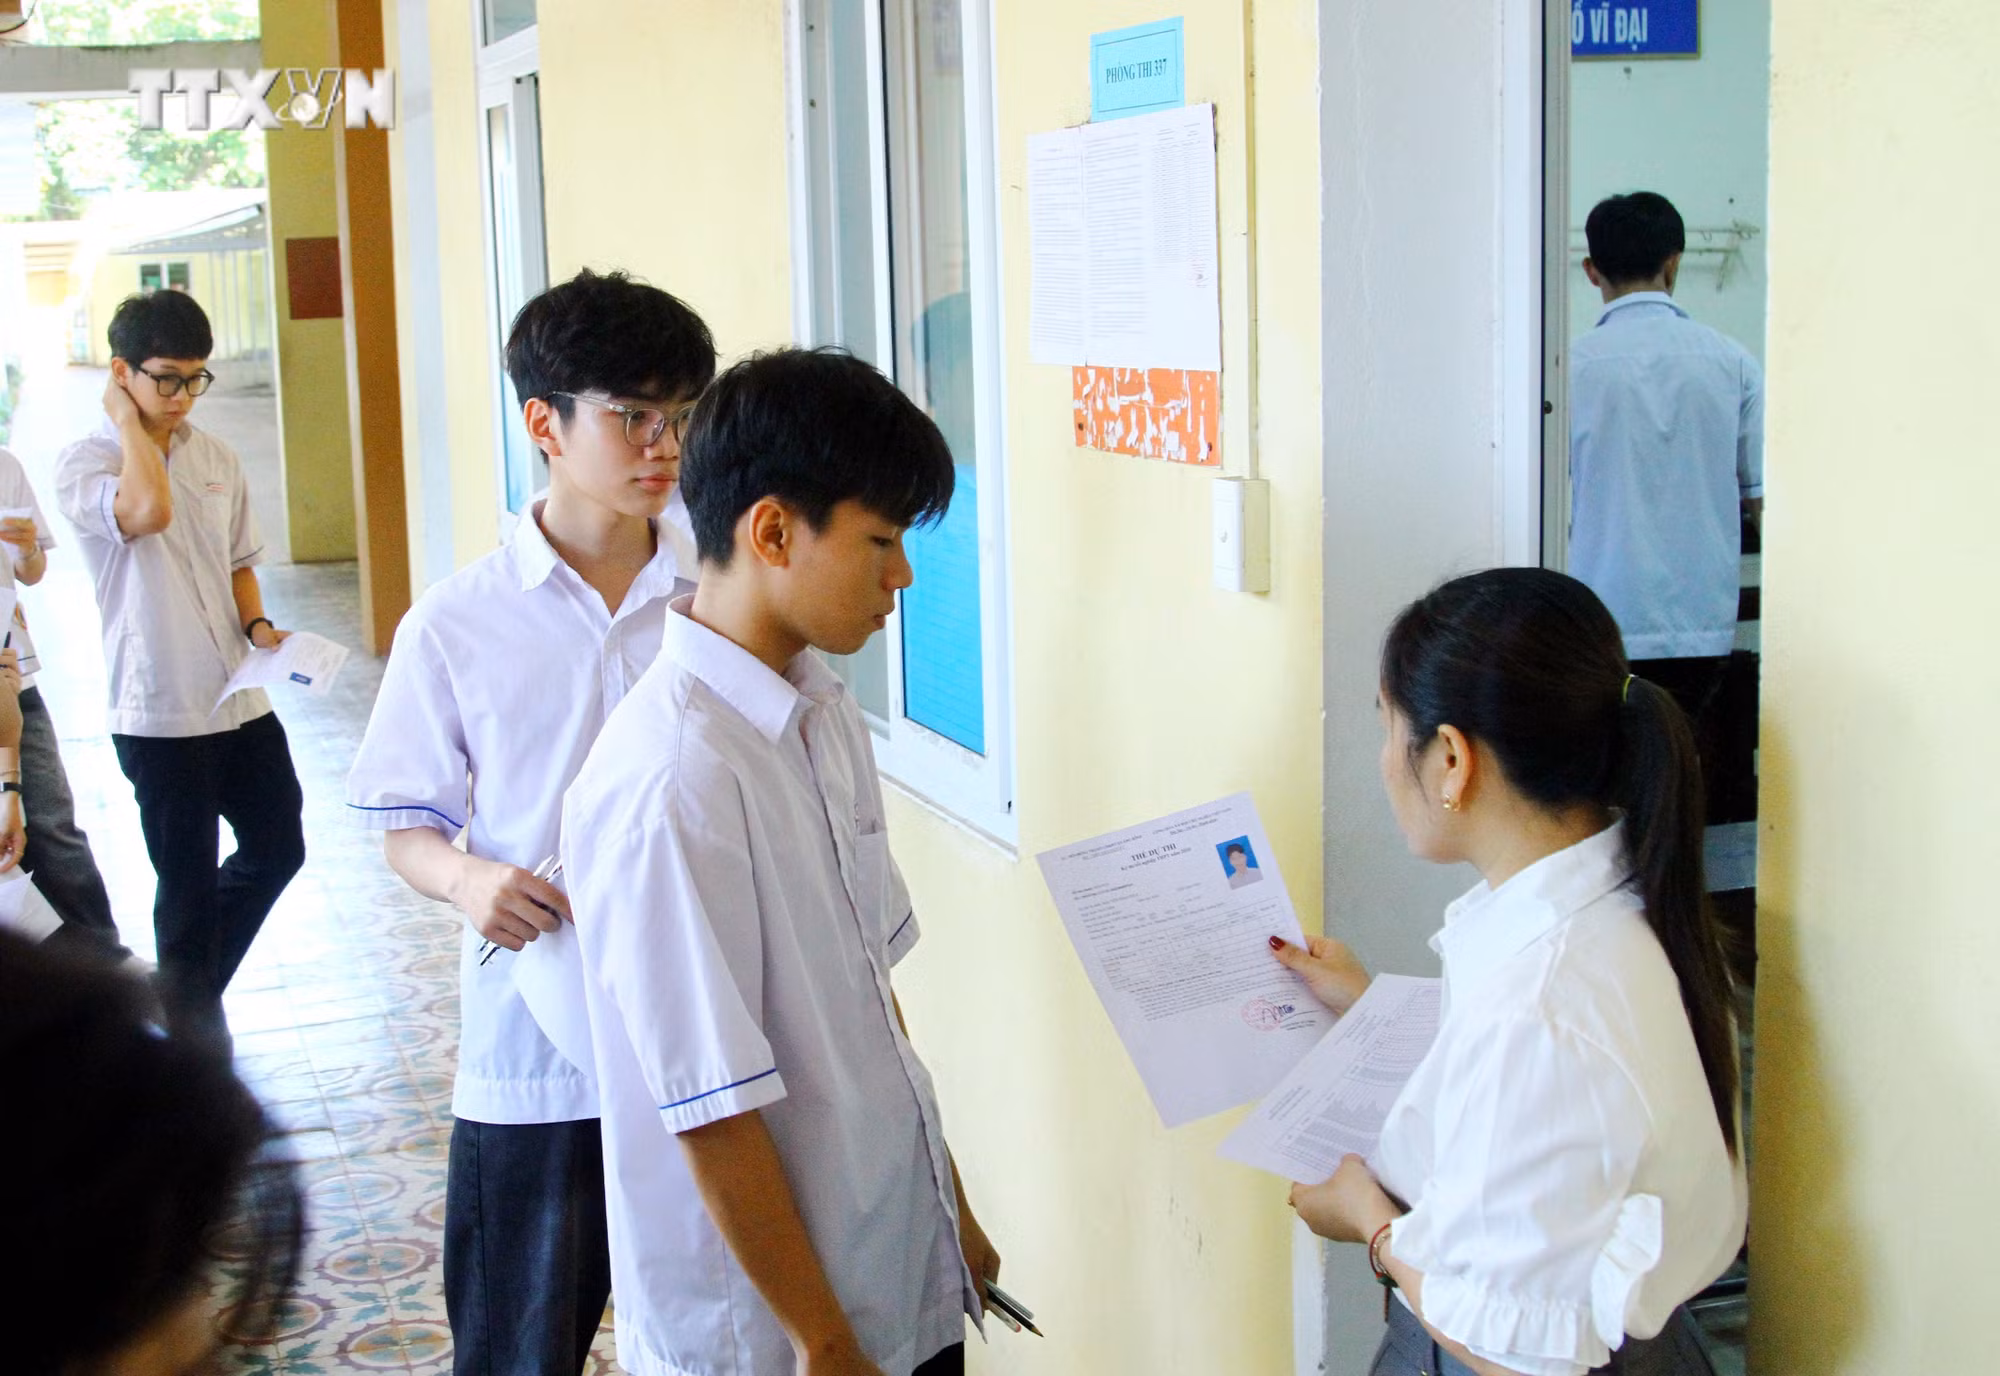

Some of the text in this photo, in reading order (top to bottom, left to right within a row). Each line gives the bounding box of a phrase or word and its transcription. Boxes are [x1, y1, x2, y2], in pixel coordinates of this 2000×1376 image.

[1589, 2, 1609, 44] VĨ
[1614, 8, 1648, 51] ĐẠI
[1106, 58, 1167, 84] PHÒNG THI 337
[1161, 843, 1177, 852] THI
